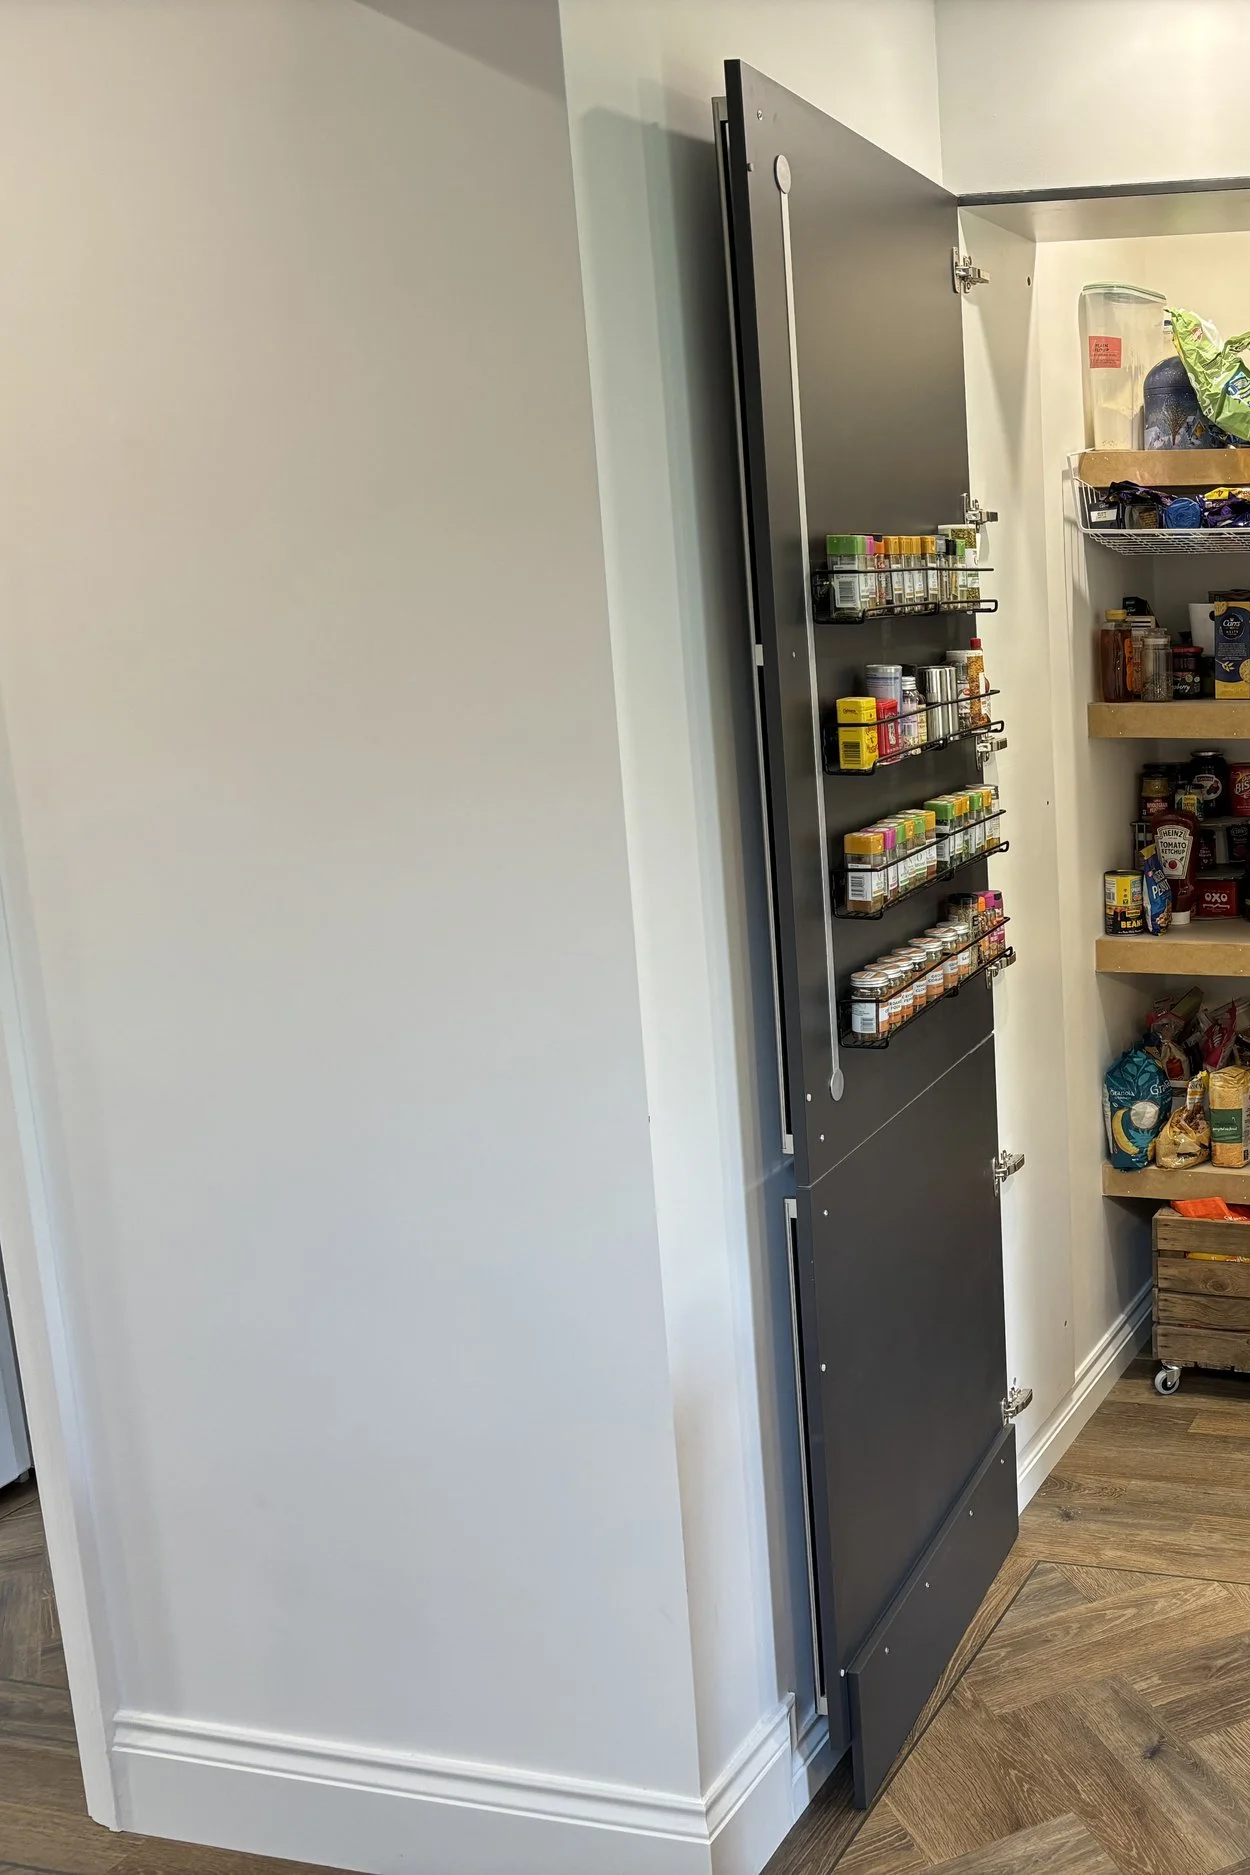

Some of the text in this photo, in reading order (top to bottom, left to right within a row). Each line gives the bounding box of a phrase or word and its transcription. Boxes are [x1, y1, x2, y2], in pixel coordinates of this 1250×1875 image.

[1162, 829, 1184, 838] HEINZ
[1160, 841, 1187, 849] TOMATO
[1161, 848, 1186, 856] KETCHUP
[1204, 892, 1228, 903] OXO
